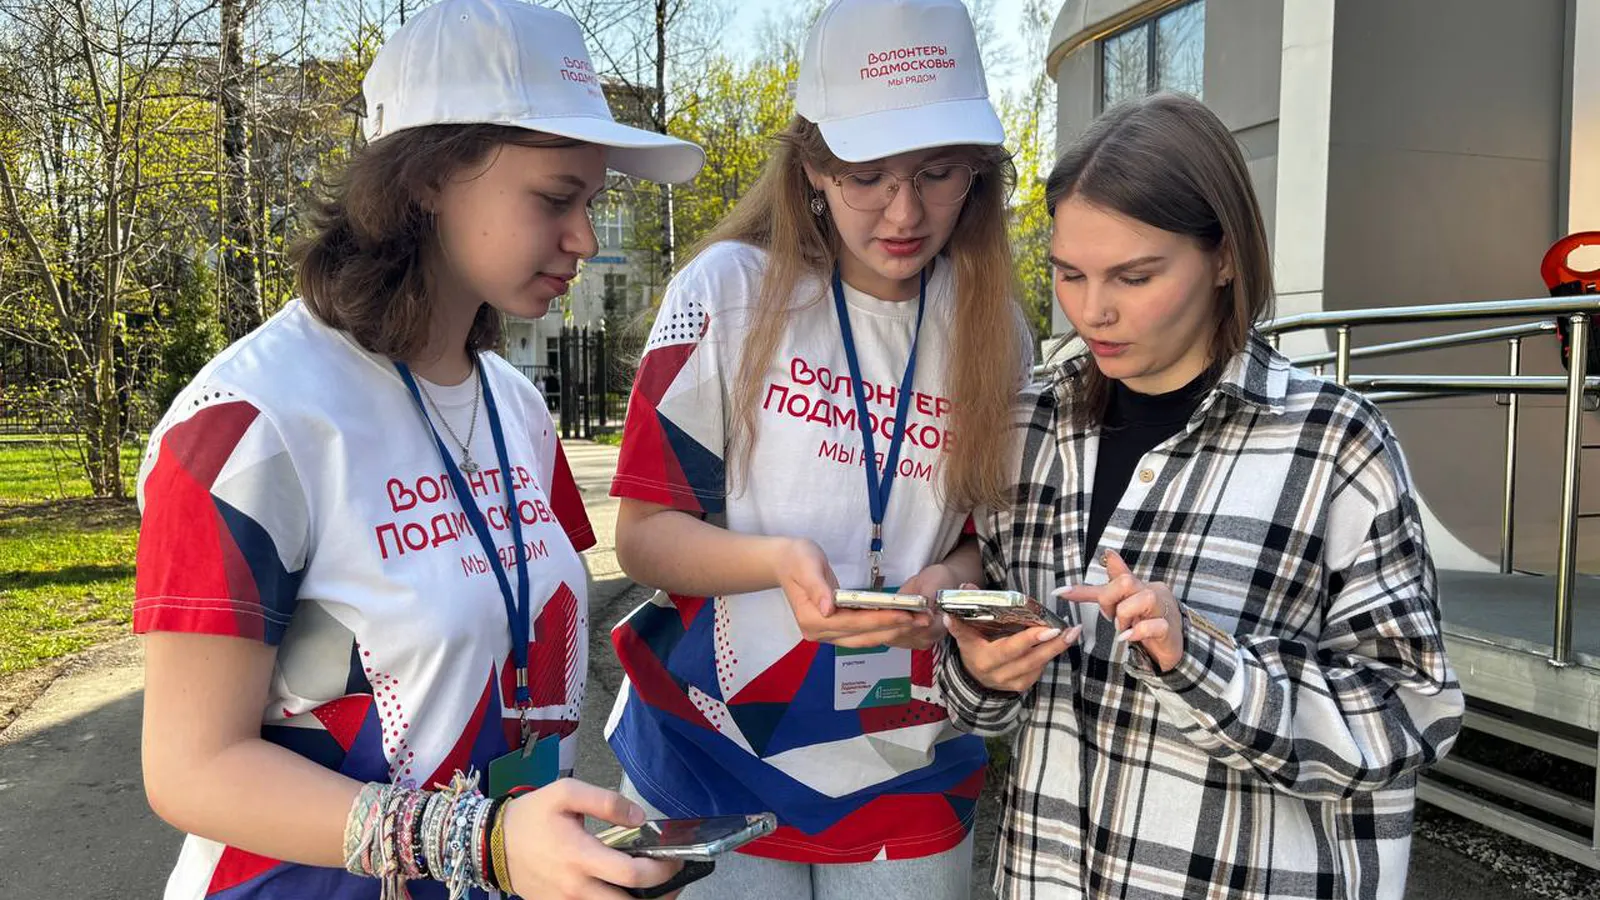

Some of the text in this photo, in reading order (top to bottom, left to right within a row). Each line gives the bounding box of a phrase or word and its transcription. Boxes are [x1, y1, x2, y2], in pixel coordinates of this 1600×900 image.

[868, 45, 947, 65] ВОЛОНТЕРЫ
[860, 59, 956, 80] ПОДМОСКОВЬЯ
[888, 74, 937, 87] МЫ РЯДОМ
[818, 440, 855, 465] МЫ
[460, 539, 549, 578] МЫ ЯДОМ
